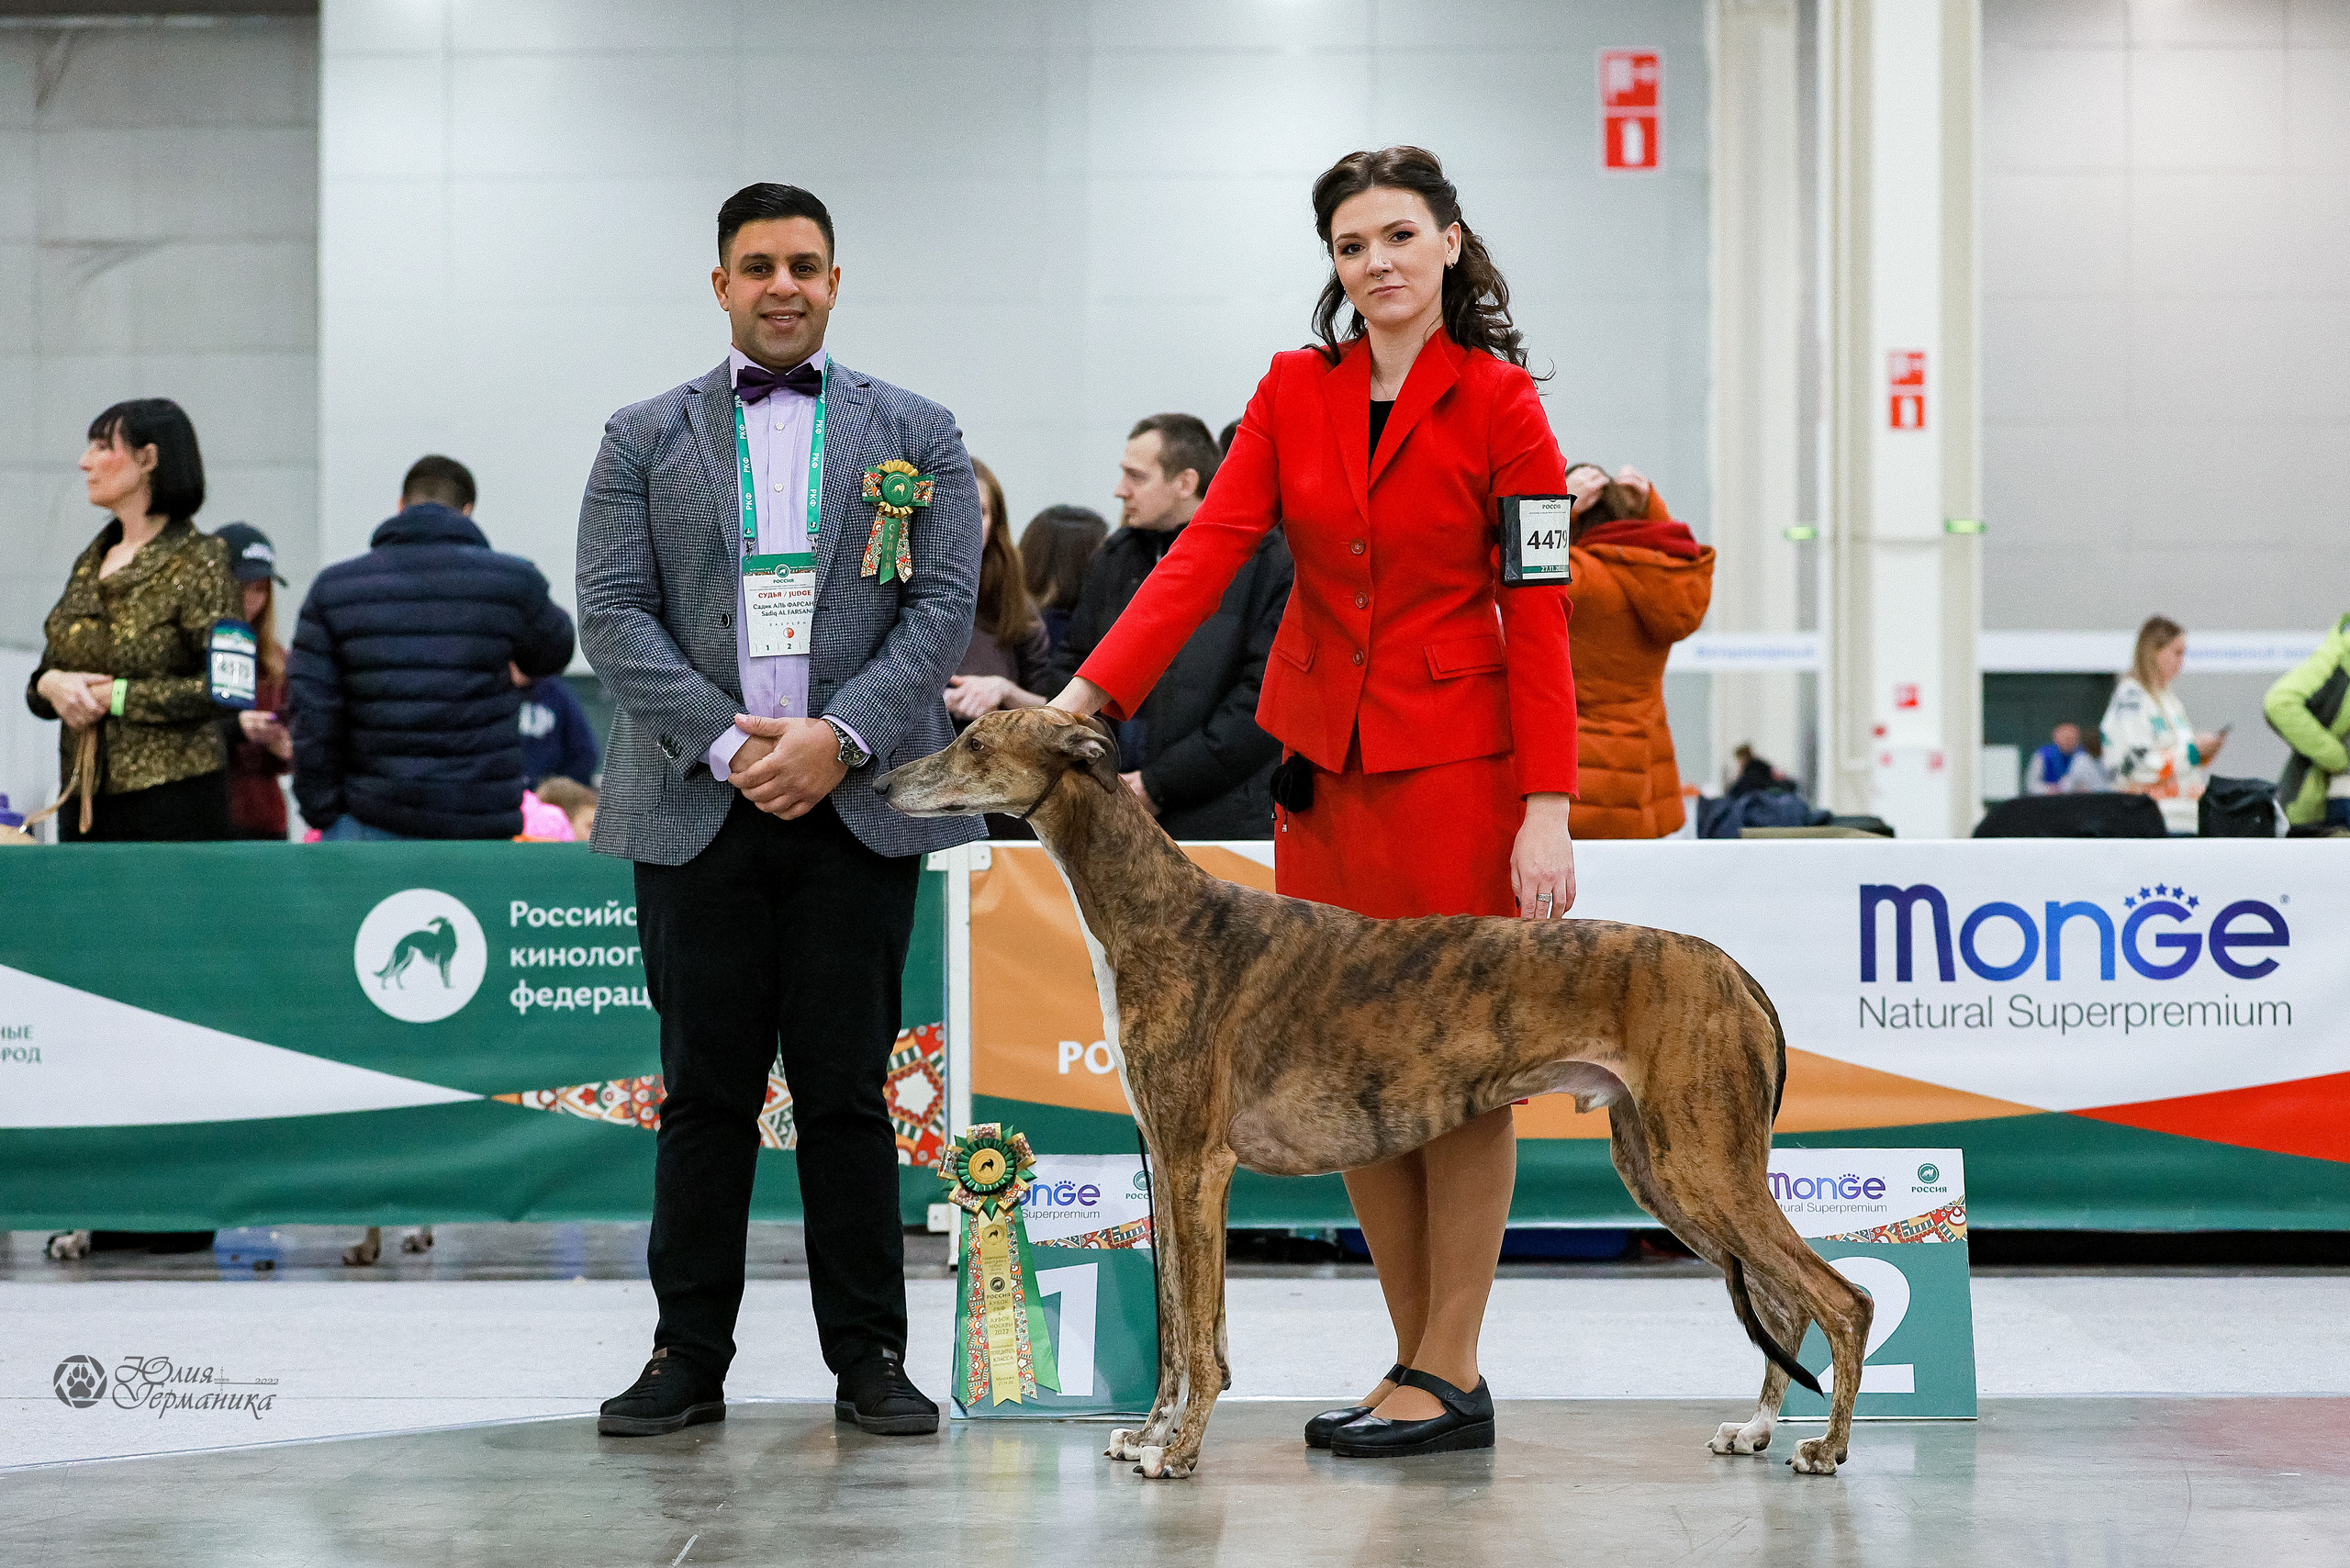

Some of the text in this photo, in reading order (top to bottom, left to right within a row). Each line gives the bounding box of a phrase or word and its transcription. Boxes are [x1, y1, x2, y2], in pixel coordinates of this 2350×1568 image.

[739, 423, 747, 440] РКФ
[815, 420, 823, 435] РКФ
[743, 456, 751, 473] РКФ
[811, 453, 820, 469] РКФ
[745, 492, 754, 510] РКФ
[809, 488, 817, 508] РКФ
[1527, 529, 1568, 550] 4479
[757, 591, 782, 599] СУДЬЯ
[789, 589, 812, 598] JUDGE
[509, 900, 637, 927] Российс
[509, 946, 643, 968] кинолог
[509, 979, 653, 1015] федерац
[1860, 993, 2292, 1036] Natural Superpremium
[1022, 1208, 1101, 1221] Superpremium
[1807, 1202, 1887, 1215] Superpremium
[1034, 1261, 1099, 1396] 1
[1817, 1256, 1916, 1394] 2
